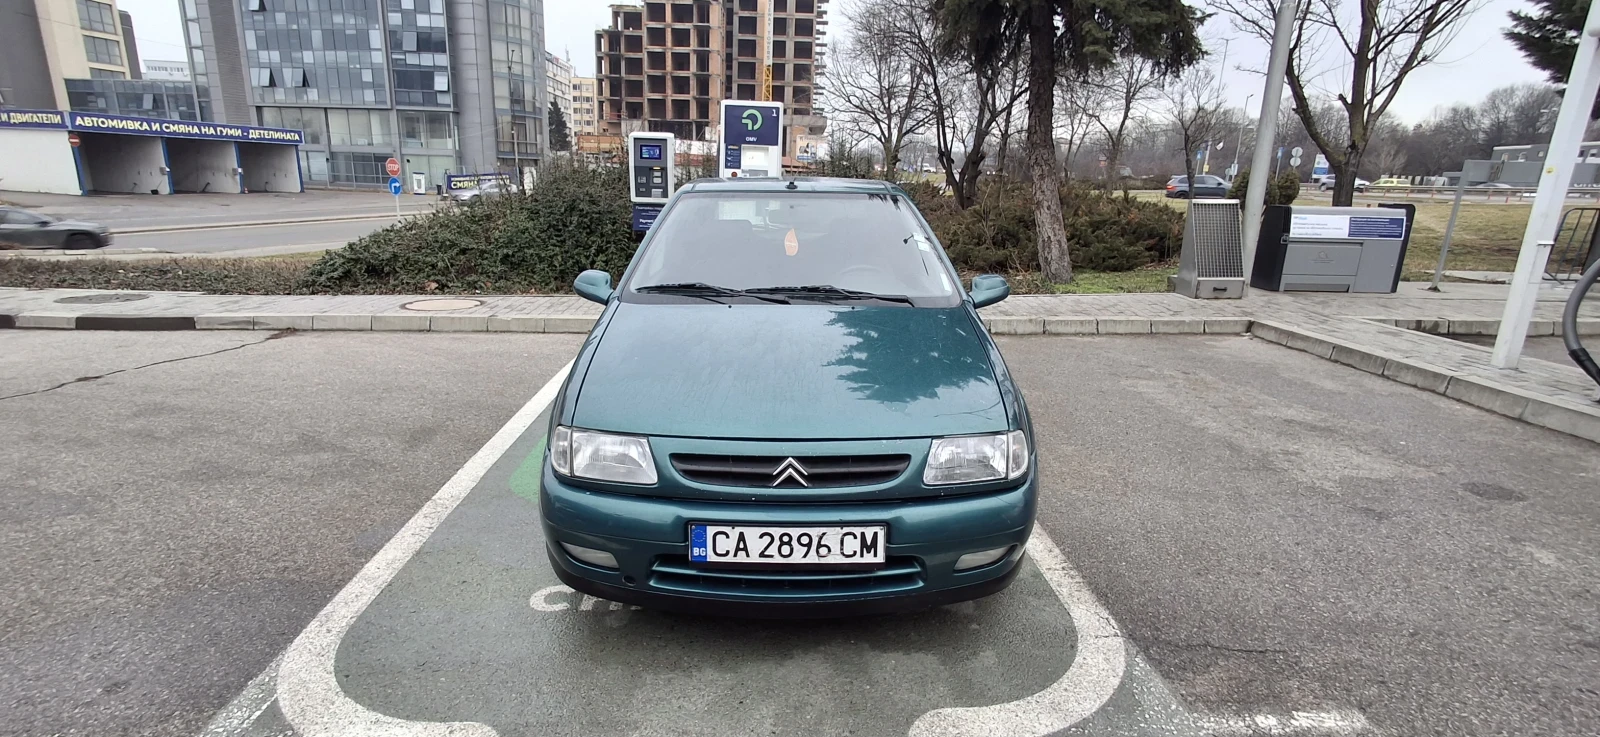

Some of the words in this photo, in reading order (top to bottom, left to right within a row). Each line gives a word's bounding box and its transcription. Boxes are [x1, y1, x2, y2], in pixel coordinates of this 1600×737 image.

[0, 113, 9, 122] И
[10, 113, 62, 124] ДВИГАТЕЛИ
[75, 116, 150, 131] АВТОМИВКА
[151, 122, 160, 132] И
[162, 123, 200, 134] СМЯНА
[200, 126, 216, 136] НА
[216, 126, 242, 137] ГУМИ
[248, 129, 300, 141] ДЕТЕЛИНАТА
[387, 163, 399, 171] STOP
[712, 531, 750, 558] CA
[758, 532, 832, 559] 2896
[839, 531, 879, 558] CM
[693, 547, 707, 556] BG
